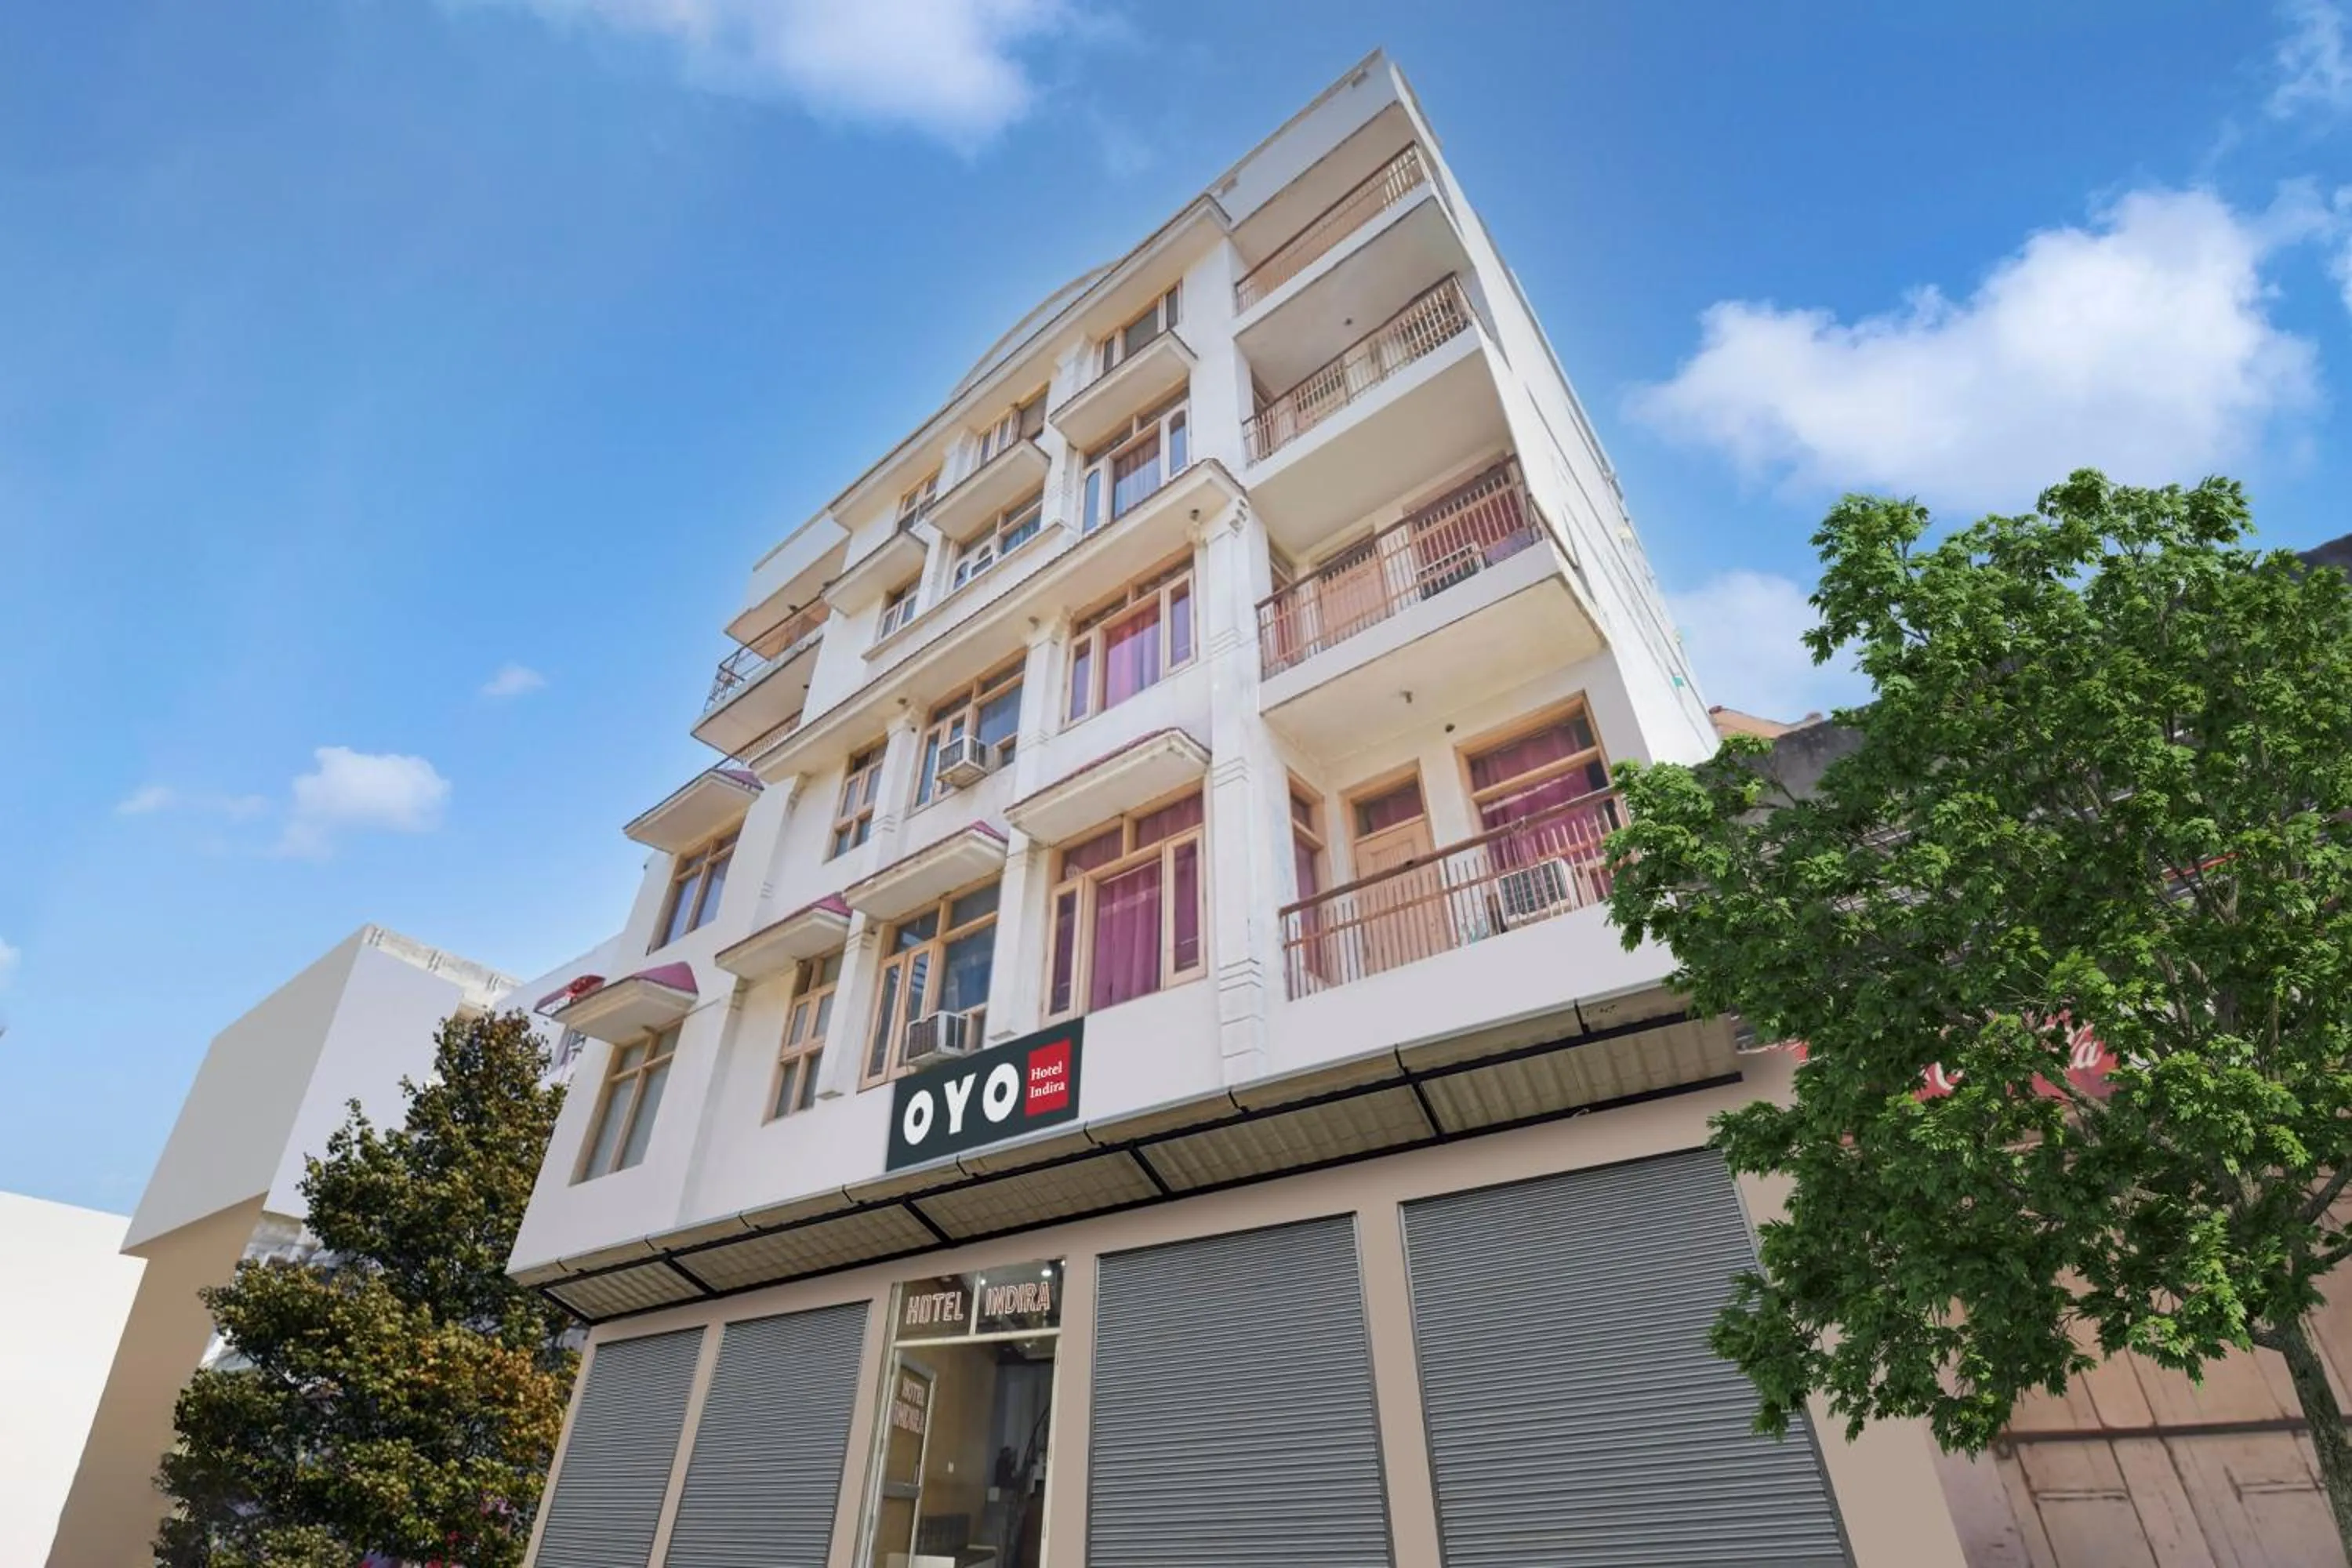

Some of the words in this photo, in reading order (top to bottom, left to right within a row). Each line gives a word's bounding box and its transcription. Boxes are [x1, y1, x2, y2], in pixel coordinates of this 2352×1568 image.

[1030, 1061, 1063, 1080] Hotel
[903, 1063, 1019, 1145] OYO
[1030, 1081, 1065, 1098] Indira
[906, 1291, 964, 1325] HOTEL
[985, 1281, 1051, 1316] INDIRA
